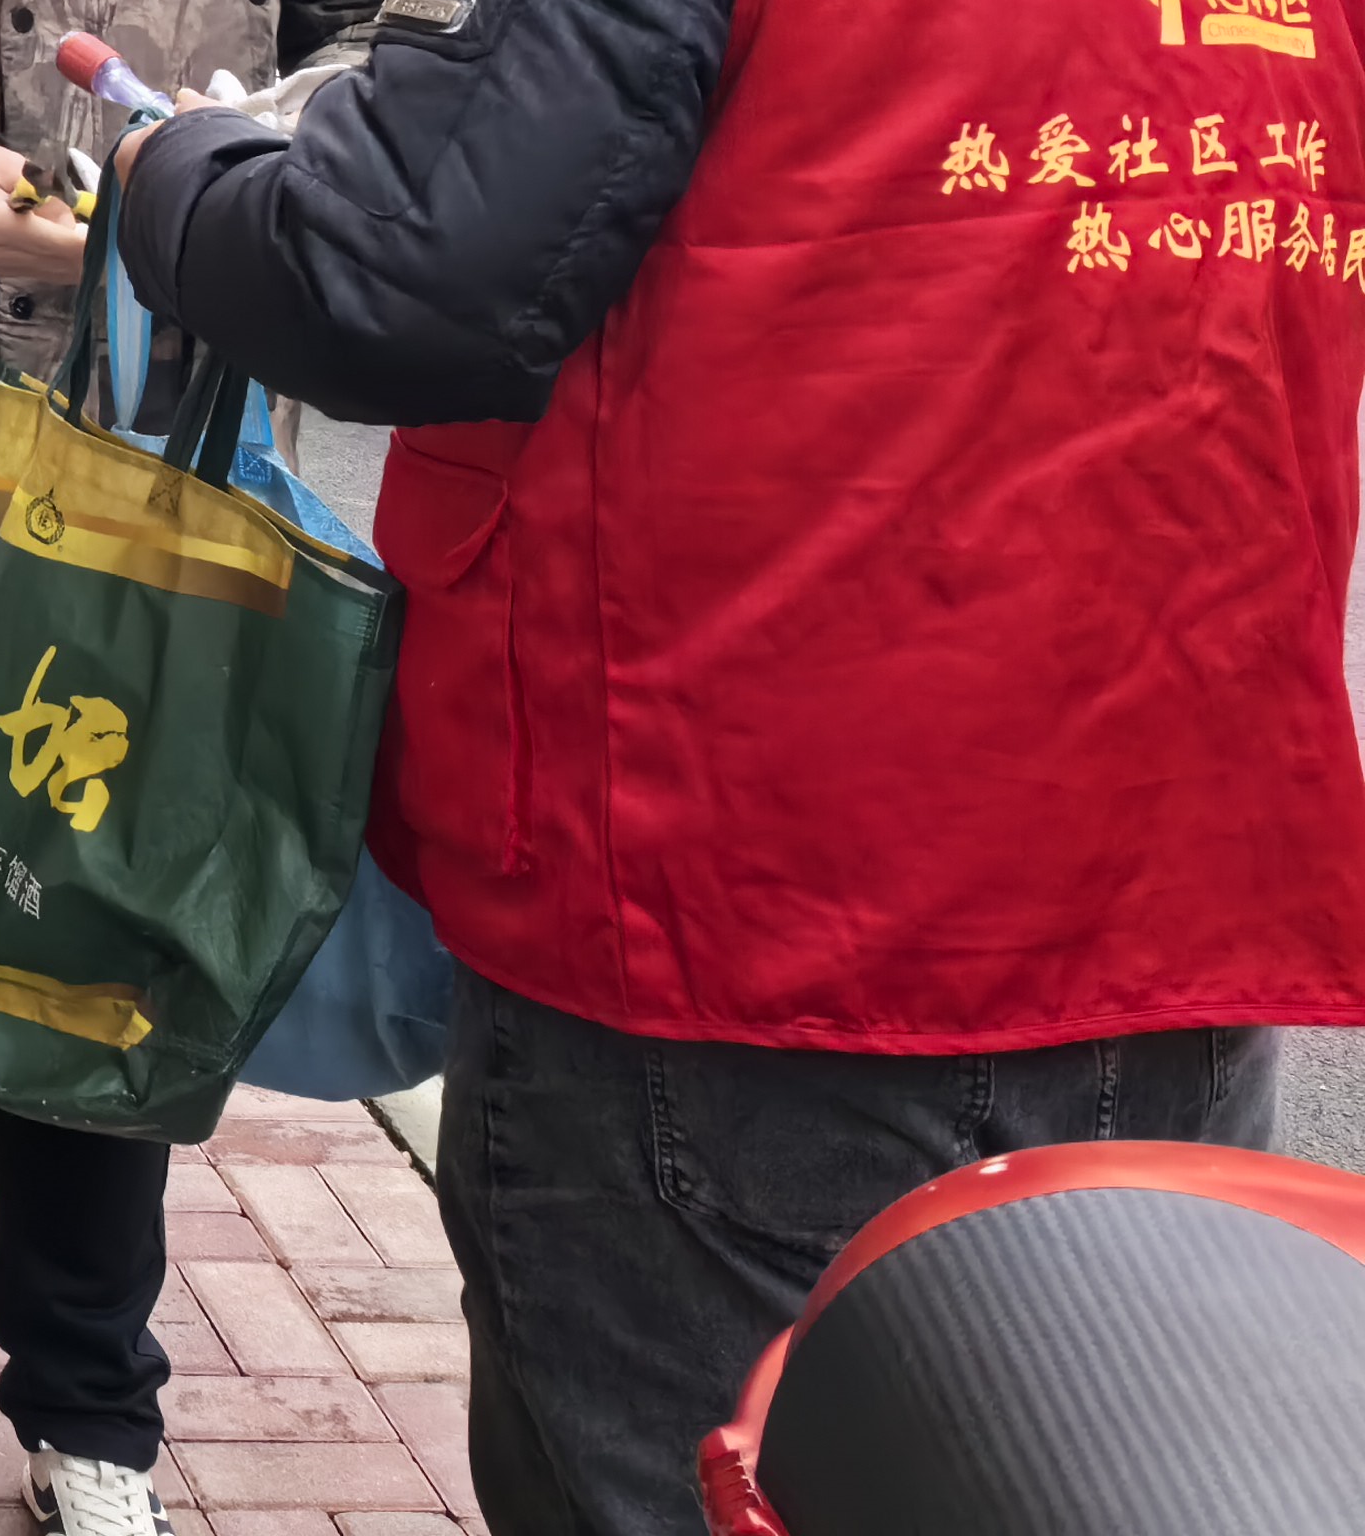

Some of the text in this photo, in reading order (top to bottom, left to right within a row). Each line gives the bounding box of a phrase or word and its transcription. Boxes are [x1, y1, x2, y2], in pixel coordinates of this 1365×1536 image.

[941, 112, 1327, 195] 热爱社区工作
